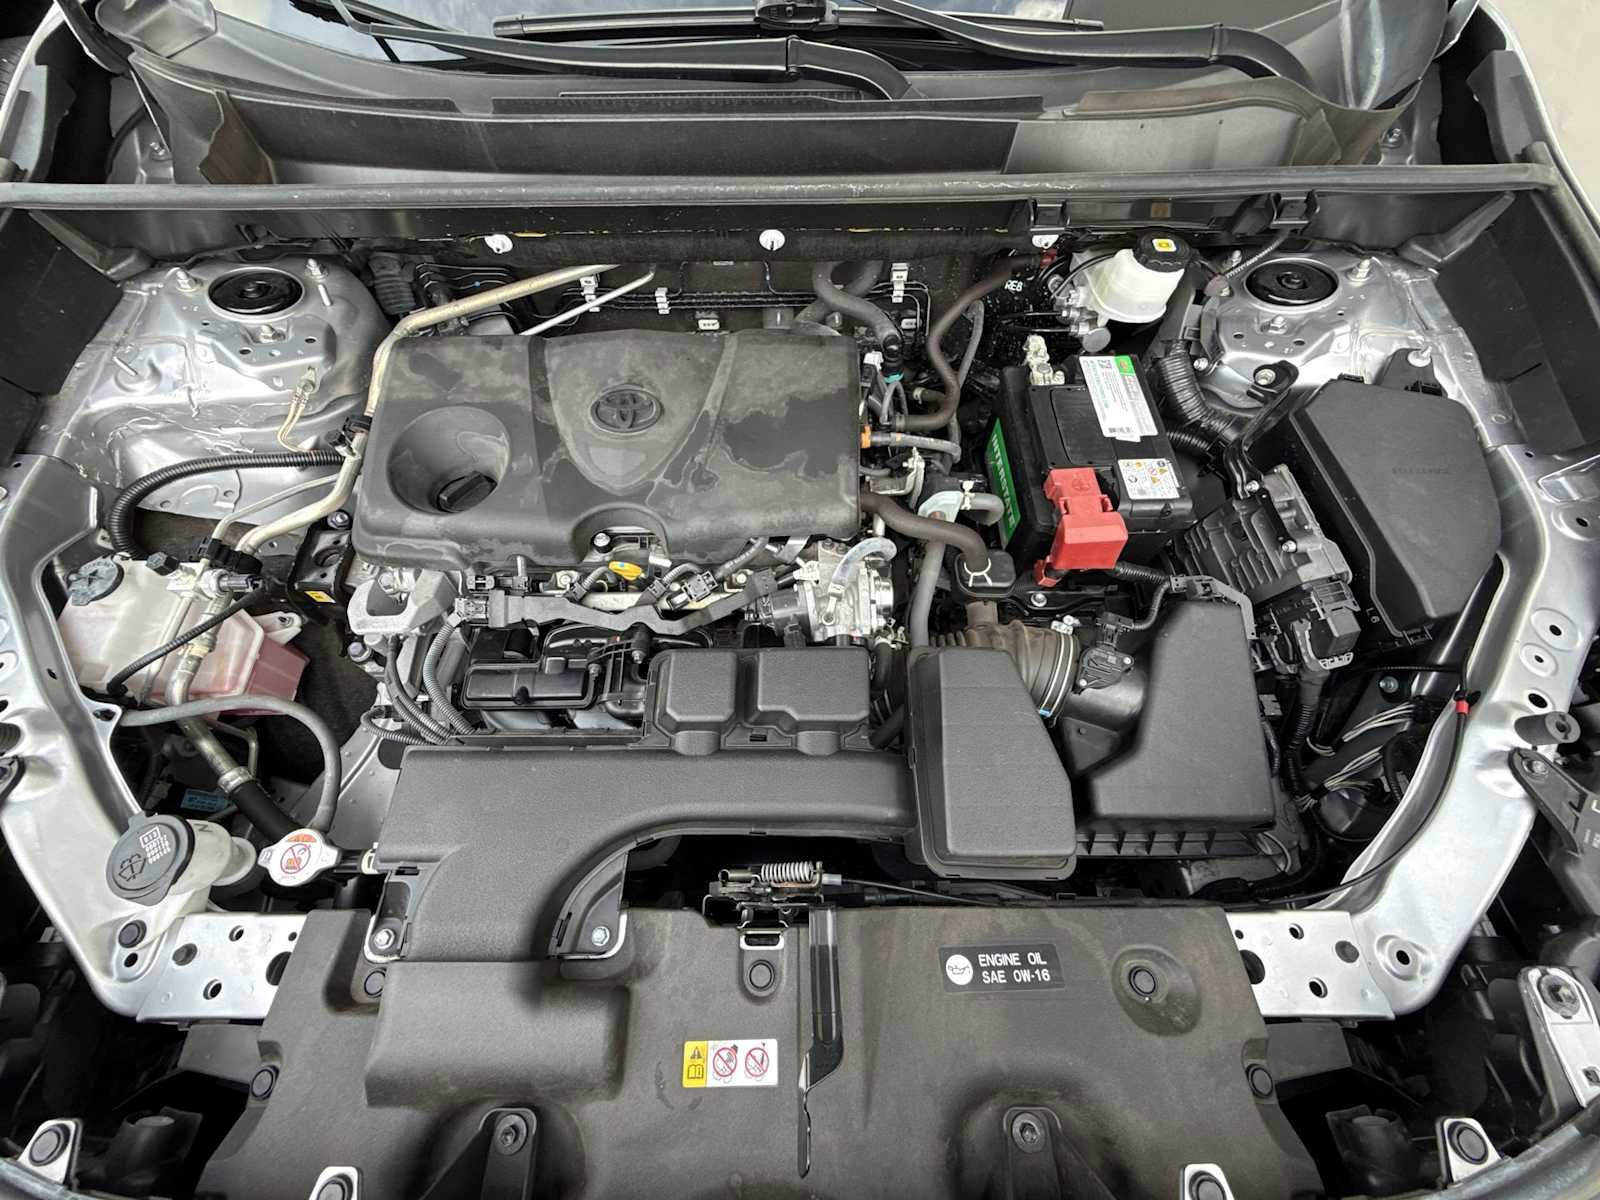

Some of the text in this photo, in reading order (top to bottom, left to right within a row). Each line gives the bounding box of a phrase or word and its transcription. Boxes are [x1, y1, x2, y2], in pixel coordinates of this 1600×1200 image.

[977, 951, 1047, 967] ENGINE OIL
[982, 968, 1051, 984] SAE 0W-16
